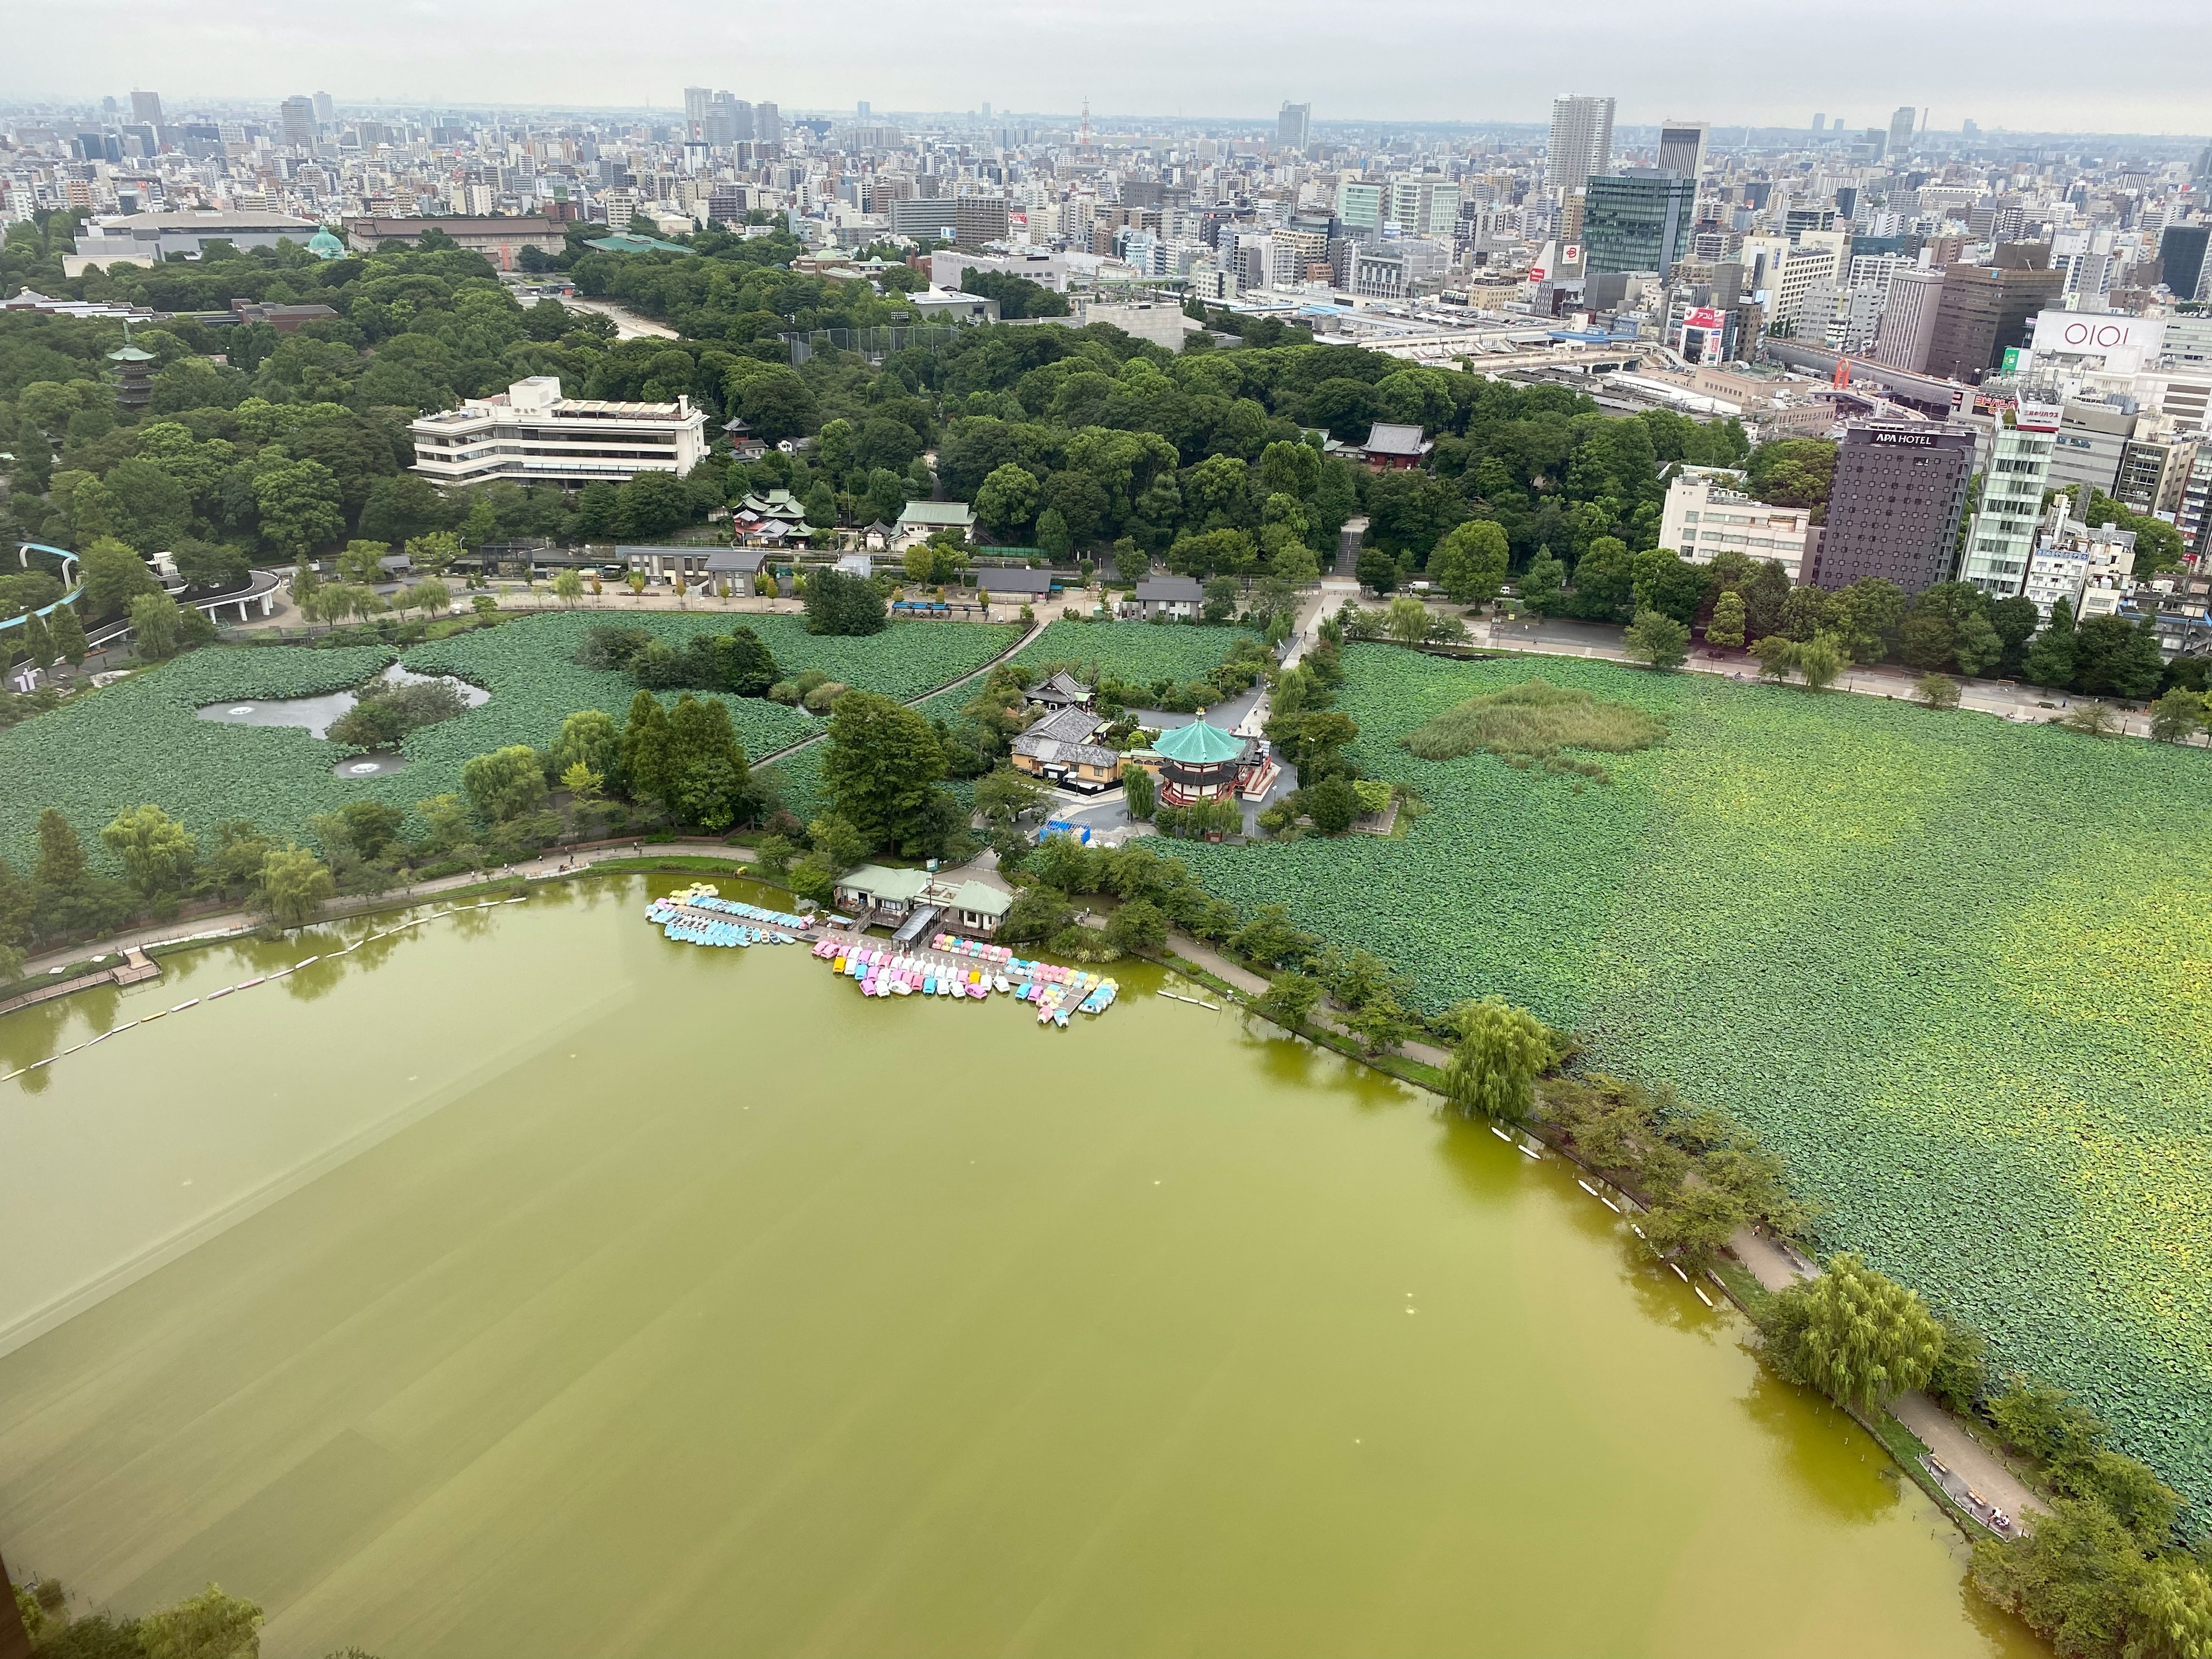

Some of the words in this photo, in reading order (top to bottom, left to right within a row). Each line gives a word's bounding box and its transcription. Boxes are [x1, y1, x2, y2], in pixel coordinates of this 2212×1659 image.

[1697, 312, 1713, 320] アコム
[1876, 433, 1896, 442] APA
[1898, 435, 1931, 445] HOTEL
[2037, 549, 2088, 560] きぬやホテル
